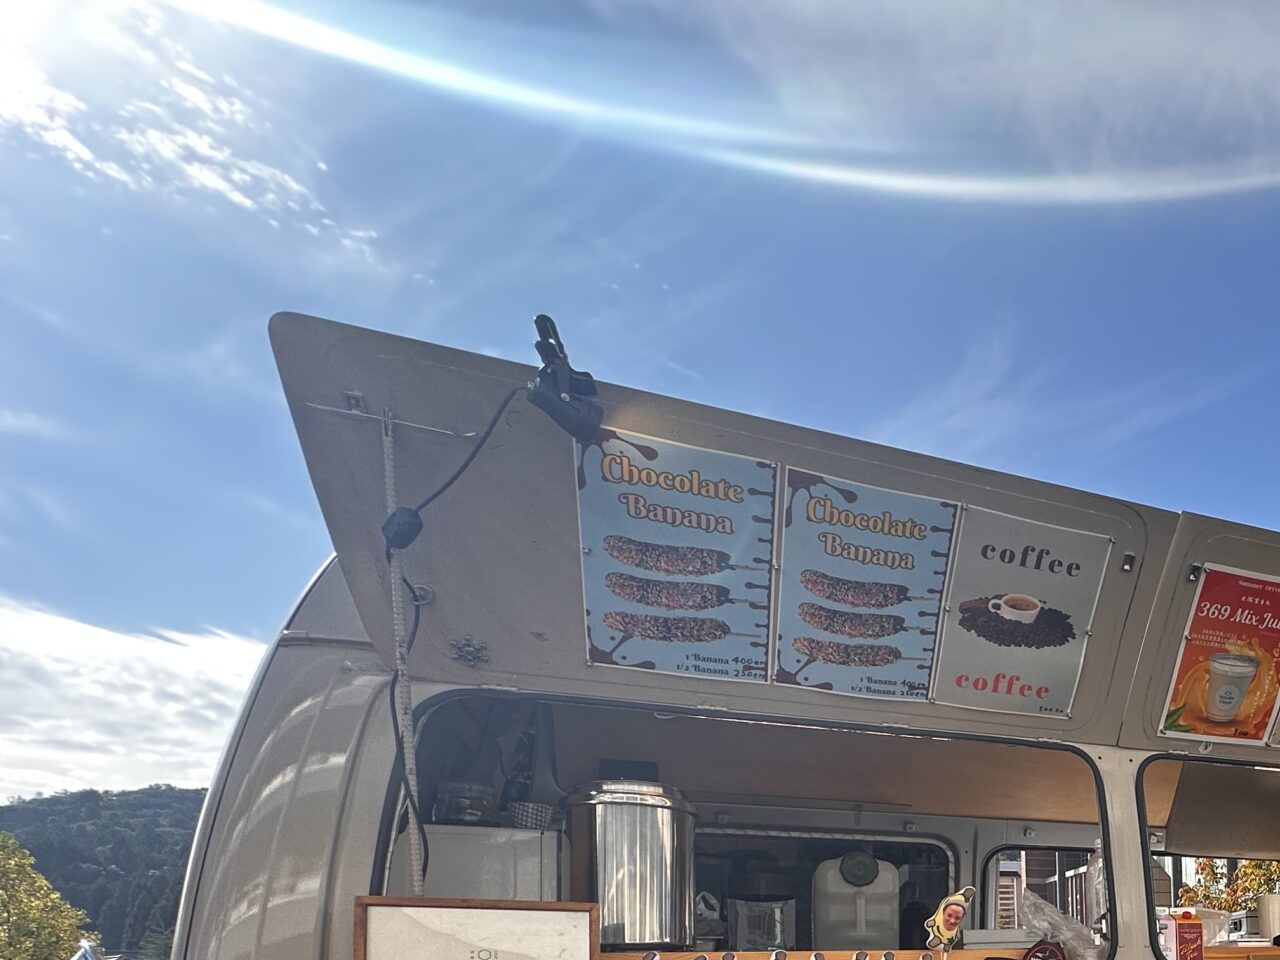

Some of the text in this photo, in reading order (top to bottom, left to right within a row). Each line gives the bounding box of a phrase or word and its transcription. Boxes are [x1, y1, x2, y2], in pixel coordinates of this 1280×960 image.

[601, 453, 744, 503] Chocolate
[618, 492, 734, 535] Banana
[806, 496, 927, 540] Chocolate
[818, 532, 915, 570] Banana
[981, 544, 1081, 577] coffee
[1198, 601, 1231, 620] 369
[1231, 608, 1260, 626] Mix
[691, 653, 729, 665] Banana
[691, 664, 729, 676] Banana
[955, 672, 1050, 700] coffee
